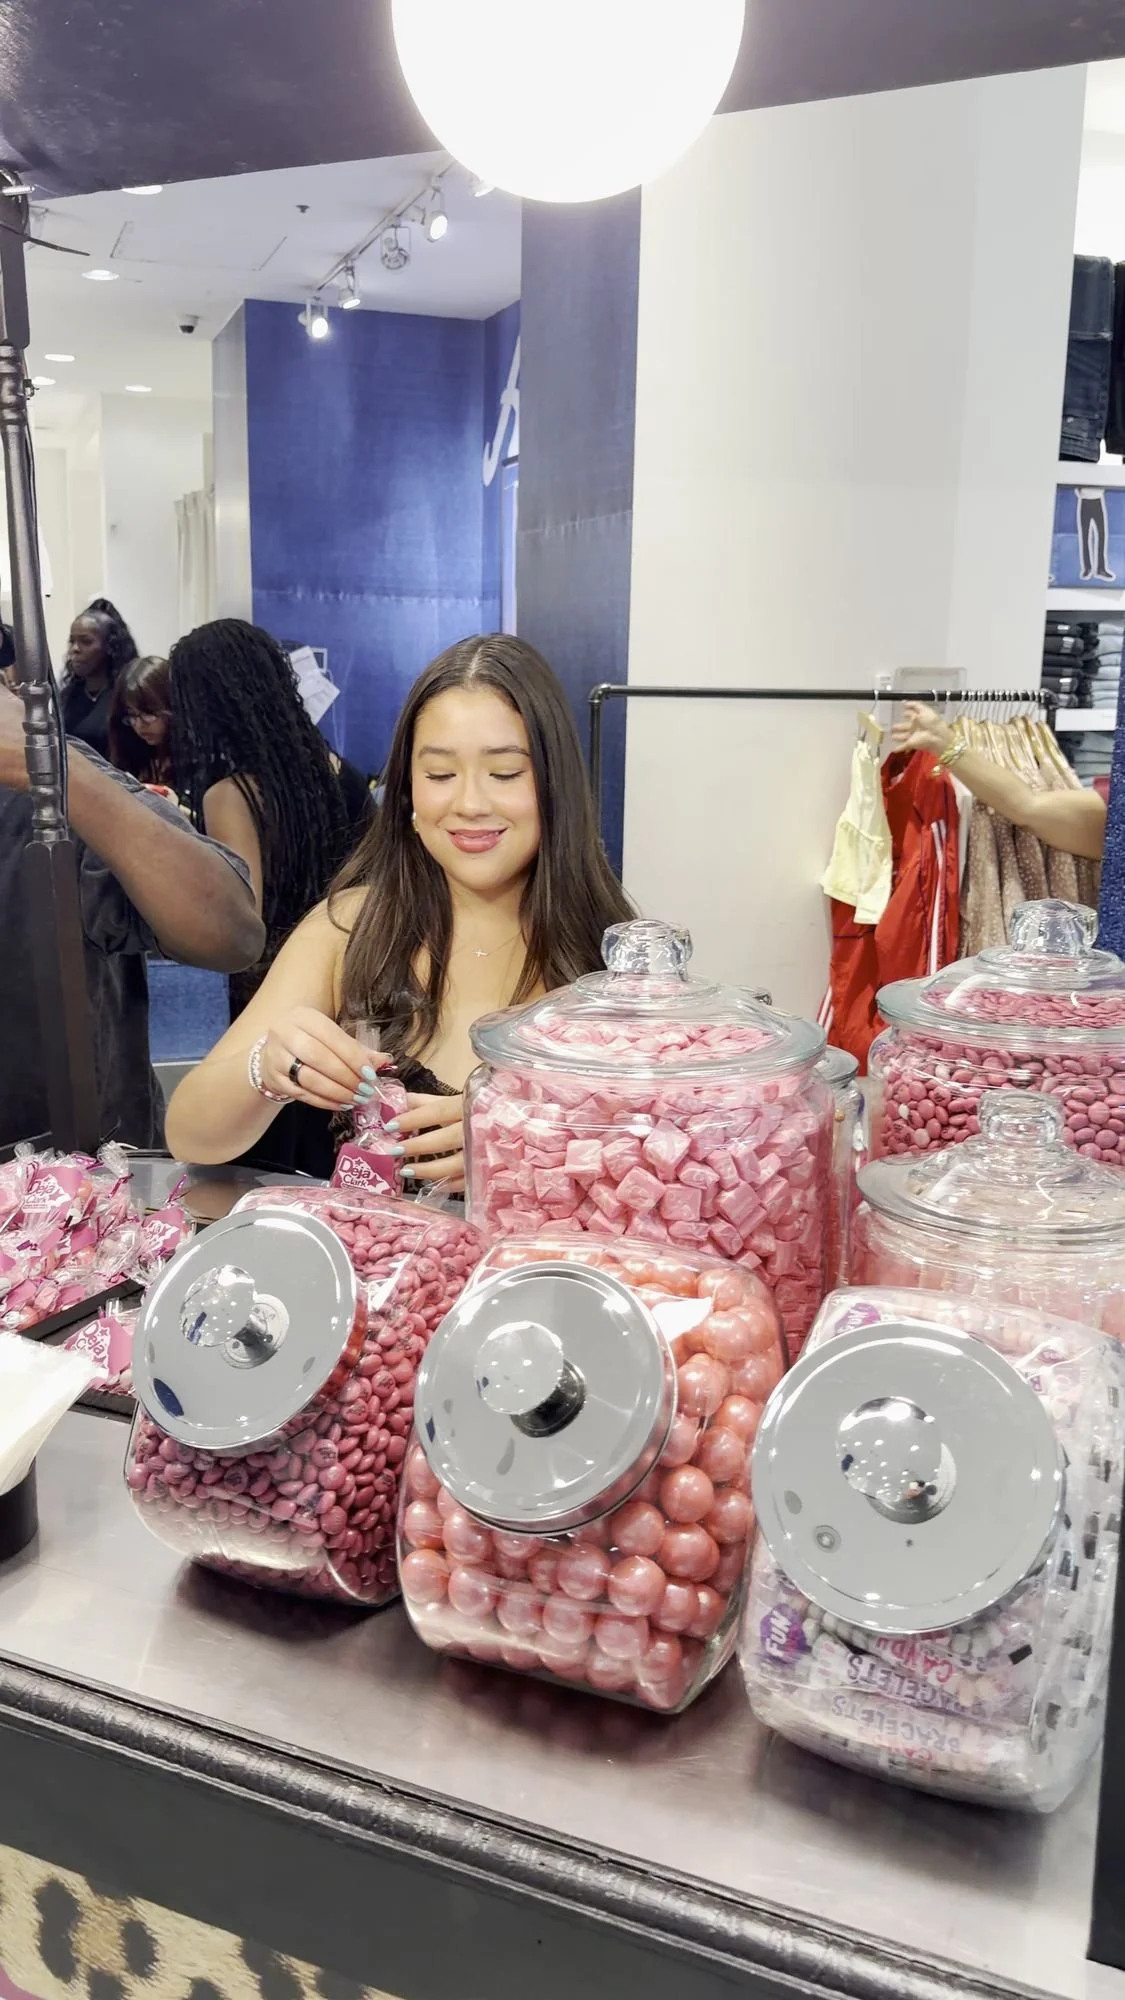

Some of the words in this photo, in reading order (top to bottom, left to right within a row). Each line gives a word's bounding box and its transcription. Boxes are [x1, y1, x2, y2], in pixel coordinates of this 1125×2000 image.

[343, 1174, 367, 1187] Clark
[765, 1610, 792, 1657] FUN
[831, 1695, 962, 1755] BRACELETS
